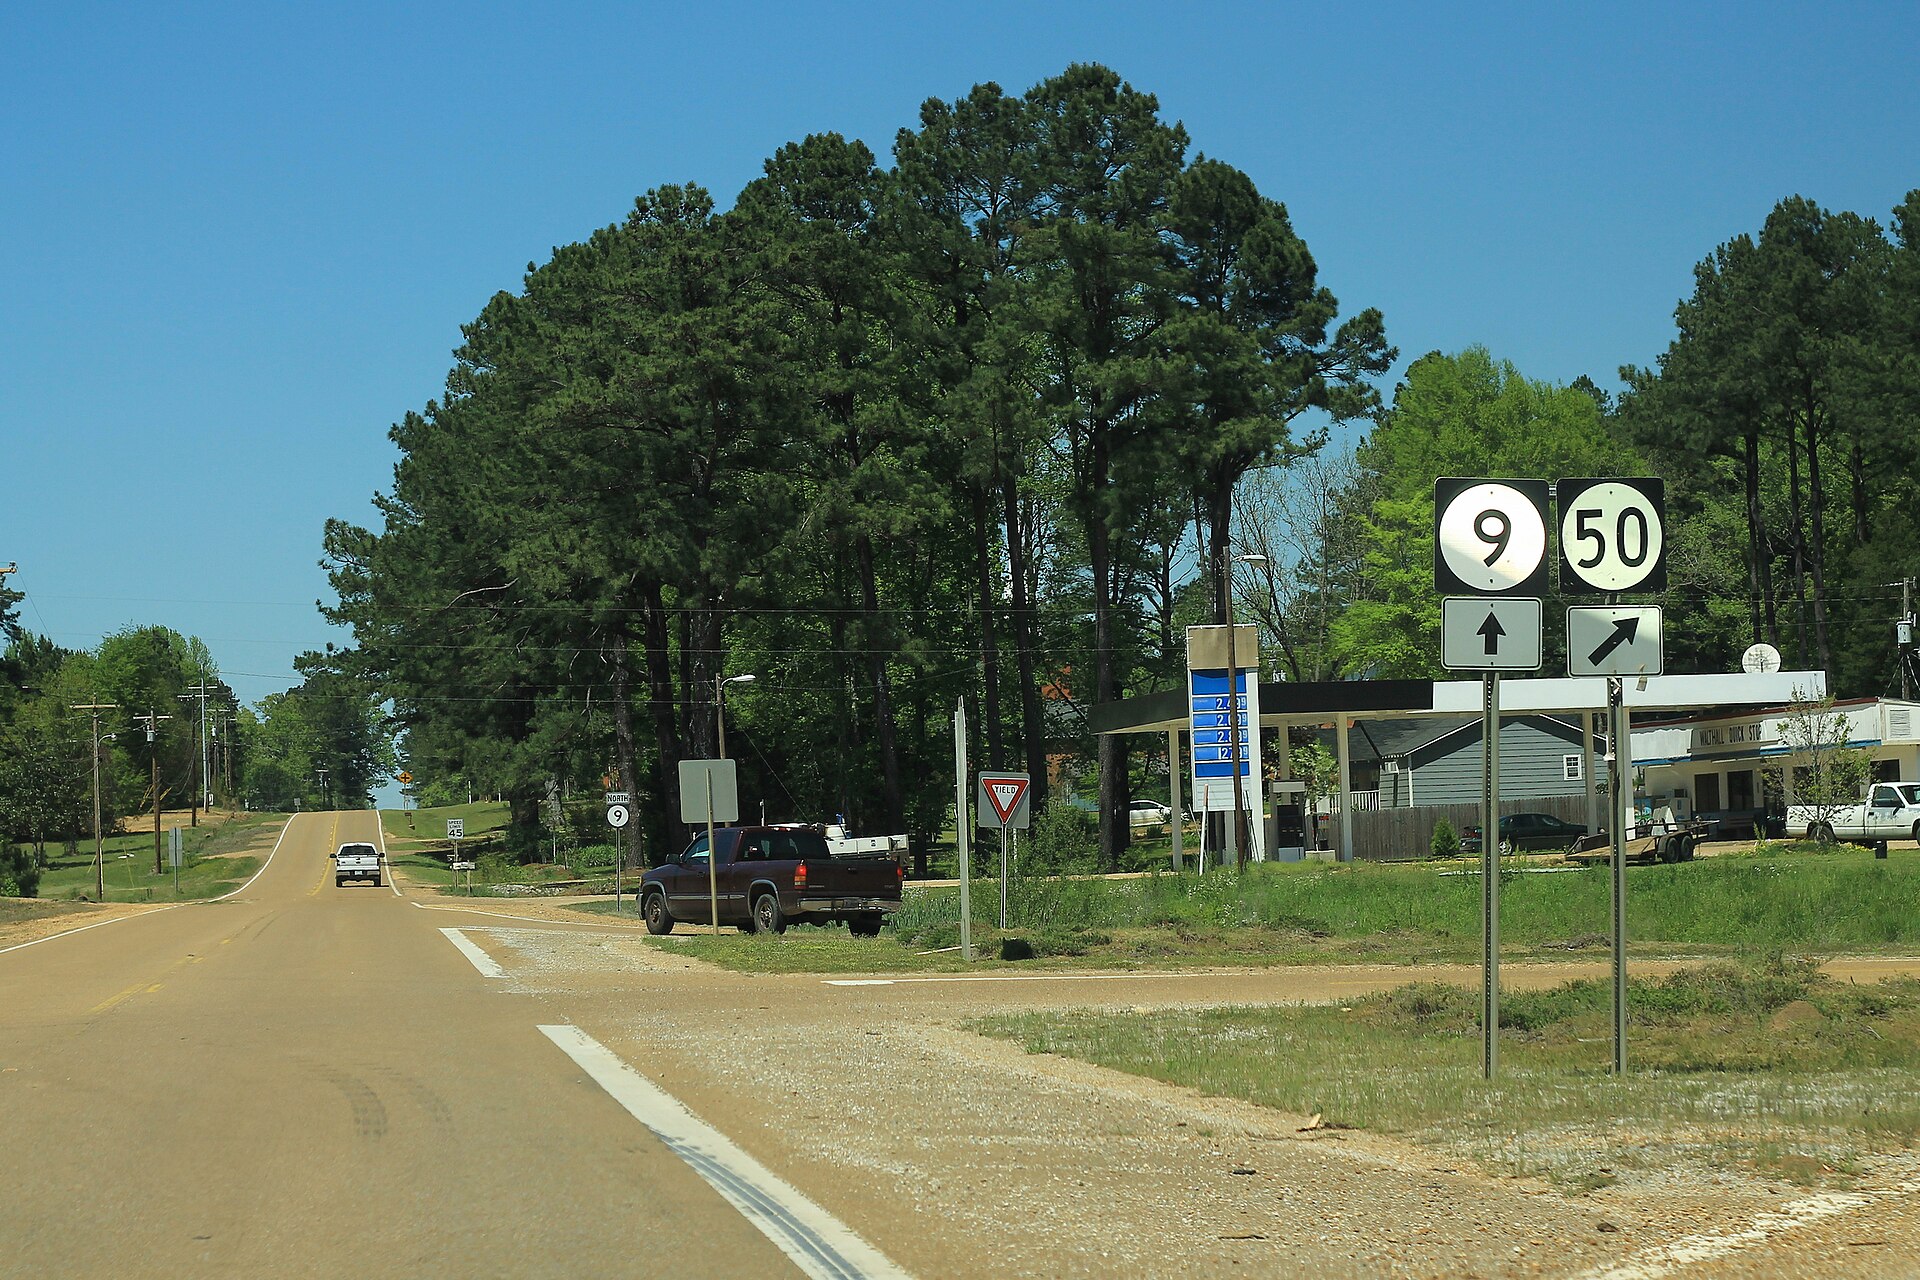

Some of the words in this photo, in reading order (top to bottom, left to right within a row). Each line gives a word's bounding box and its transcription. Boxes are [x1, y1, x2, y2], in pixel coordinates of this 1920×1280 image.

[1474, 509, 1511, 567] 9
[1576, 507, 1649, 568] 50
[1729, 725, 1745, 743] QUICK
[994, 786, 1016, 794] YIELD
[607, 794, 629, 802] NORTH
[614, 810, 623, 822] 9
[448, 828, 463, 837] 45
